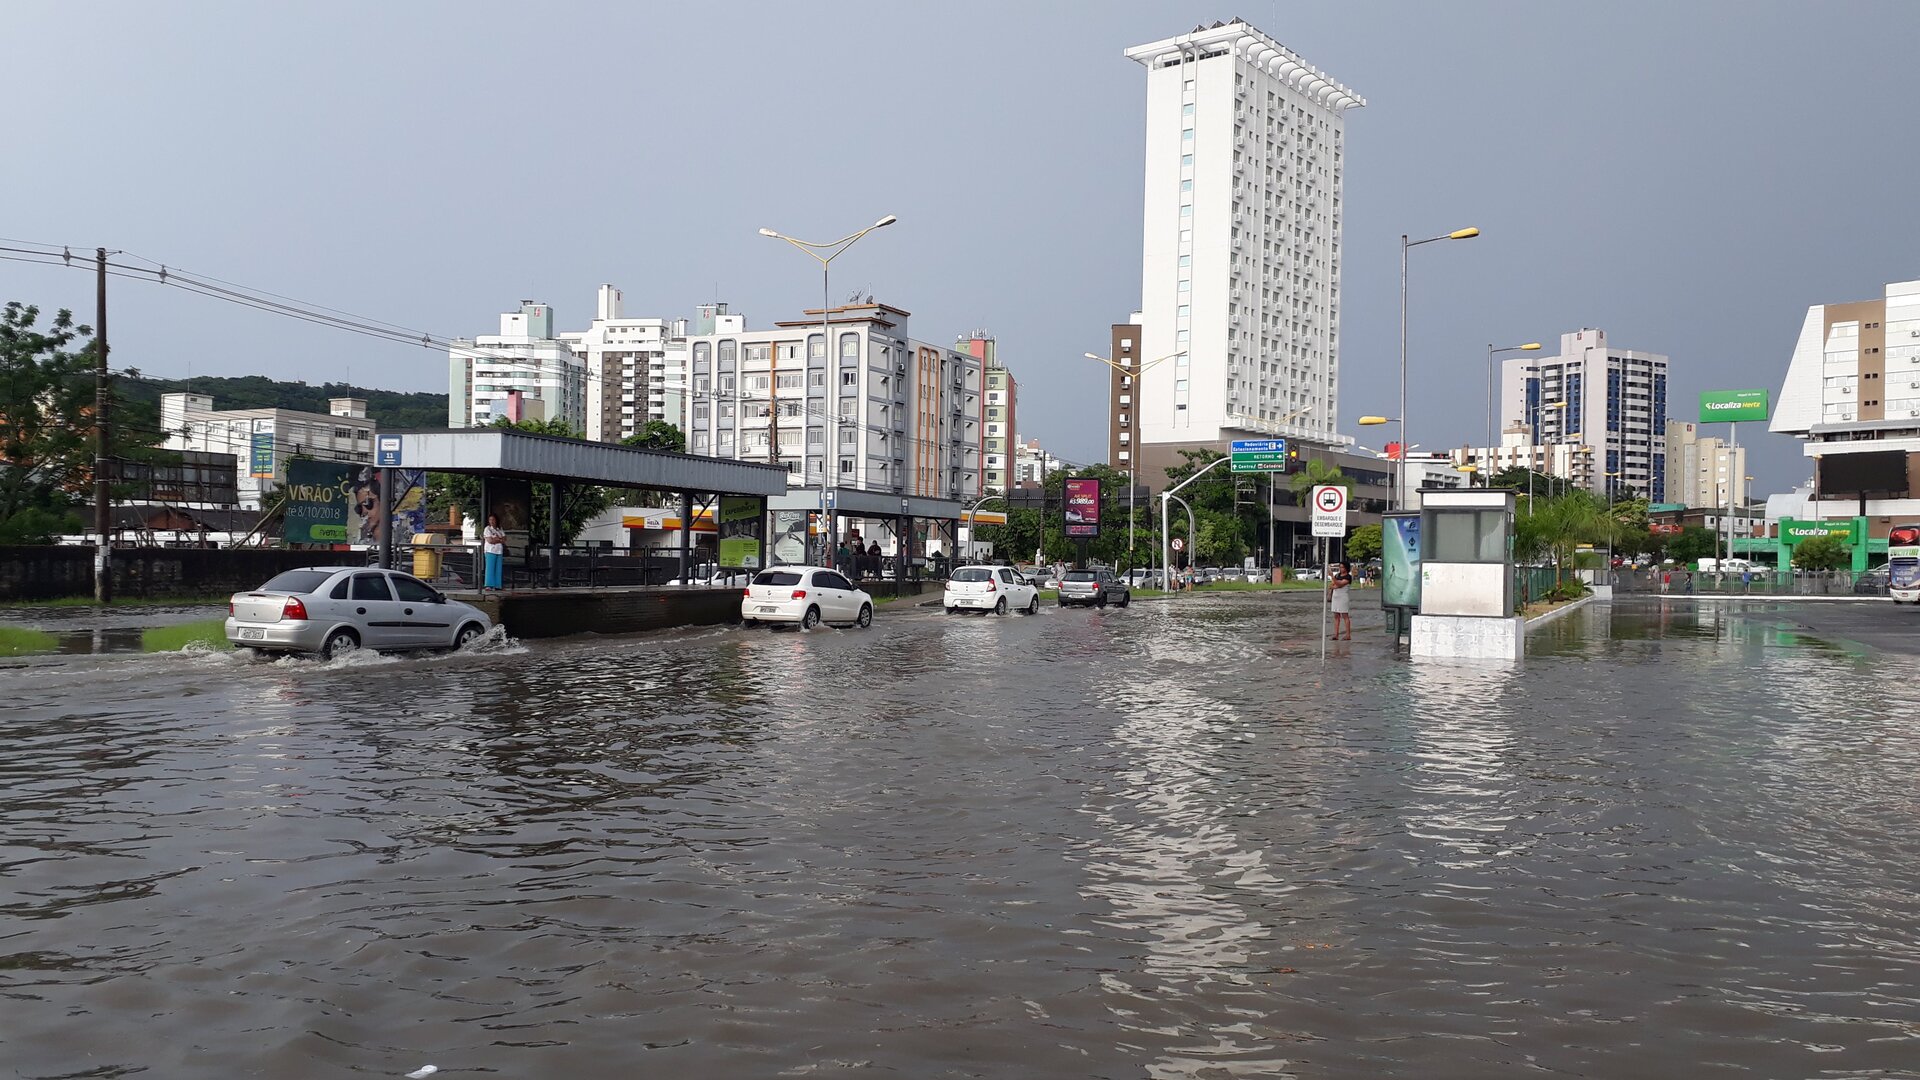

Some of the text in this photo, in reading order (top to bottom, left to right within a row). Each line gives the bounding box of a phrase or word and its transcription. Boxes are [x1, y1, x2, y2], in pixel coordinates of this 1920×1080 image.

[1711, 401, 1761, 410] Localiza Hertz
[289, 483, 333, 503] VERÃO
[298, 506, 341, 520] 8/10/2018
[1795, 527, 1828, 536] Localiza
